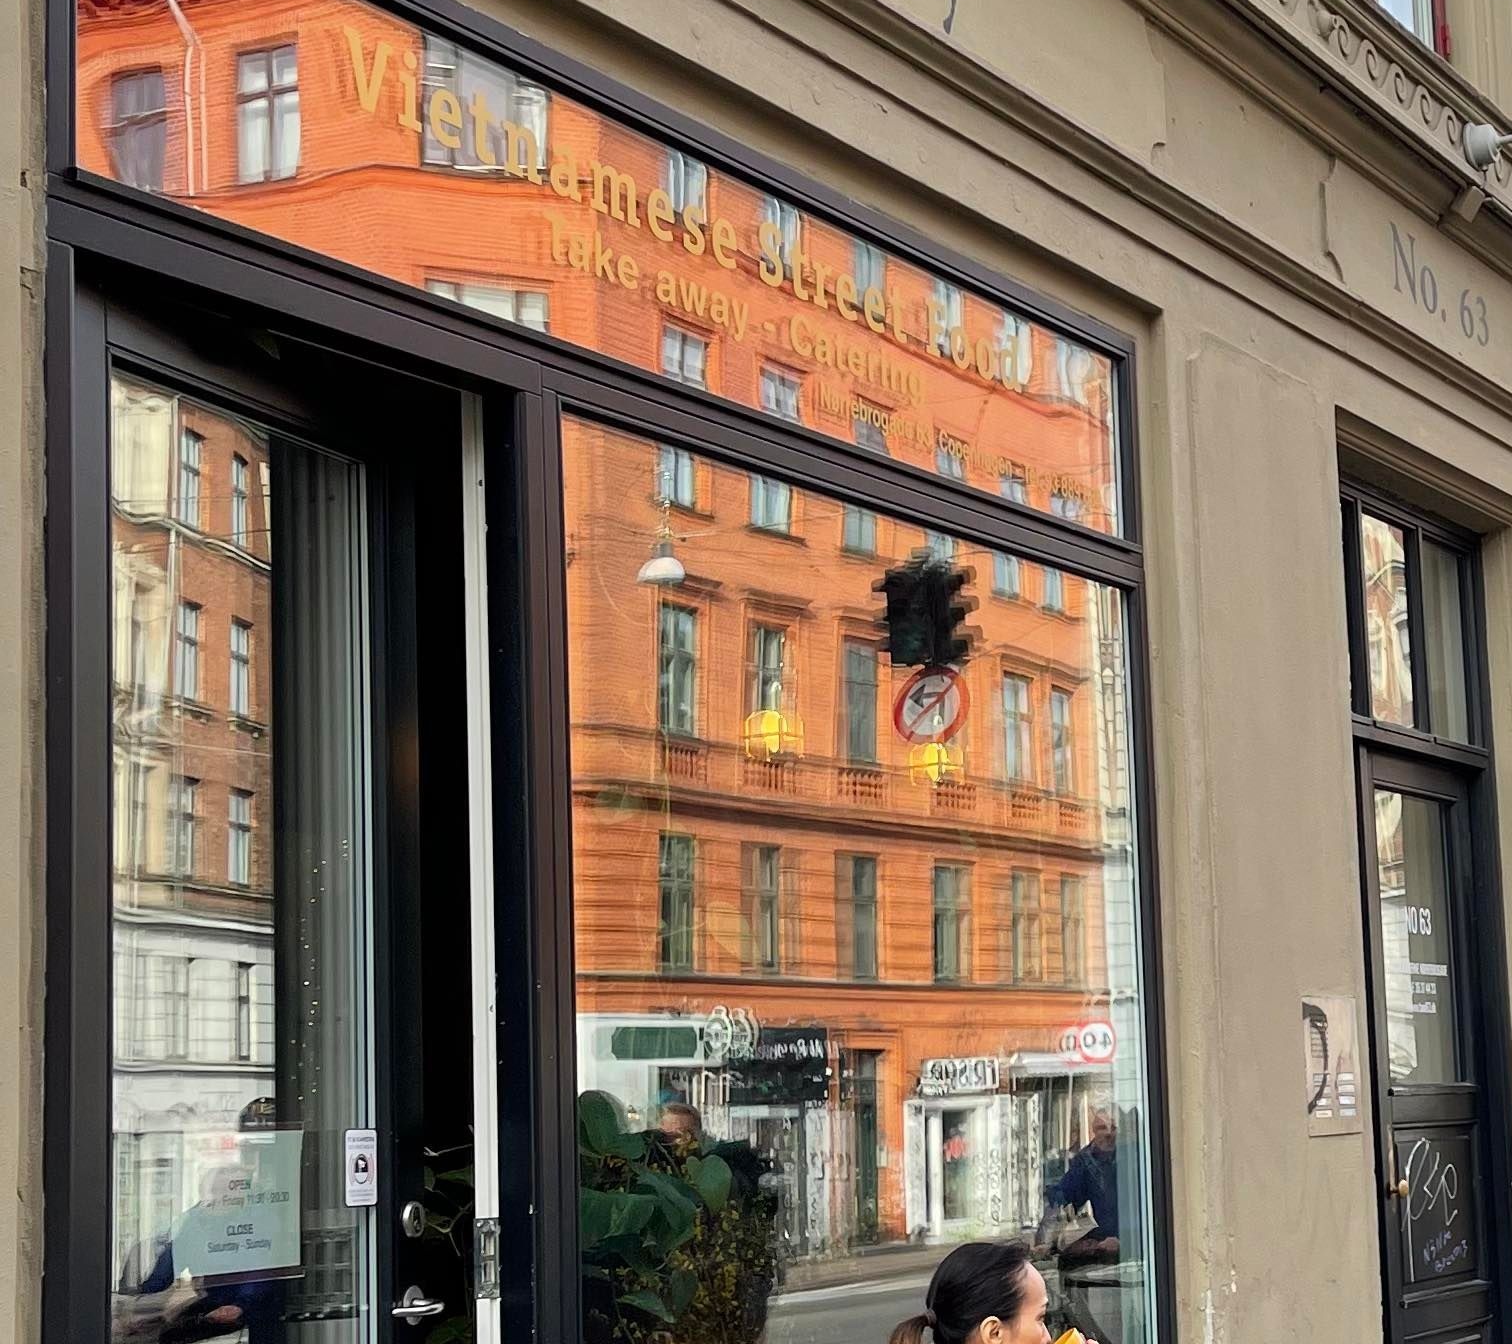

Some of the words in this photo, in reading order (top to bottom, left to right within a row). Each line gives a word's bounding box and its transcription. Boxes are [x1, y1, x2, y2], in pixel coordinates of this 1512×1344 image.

[344, 24, 738, 269] Vietnamese
[757, 220, 908, 344] Street
[926, 299, 1022, 394] Food
[1390, 221, 1446, 323] No.
[1460, 289, 1489, 347] 63
[543, 208, 640, 290] Take
[655, 268, 749, 343] away
[789, 312, 926, 409] Catering
[1419, 906, 1432, 936] 63
